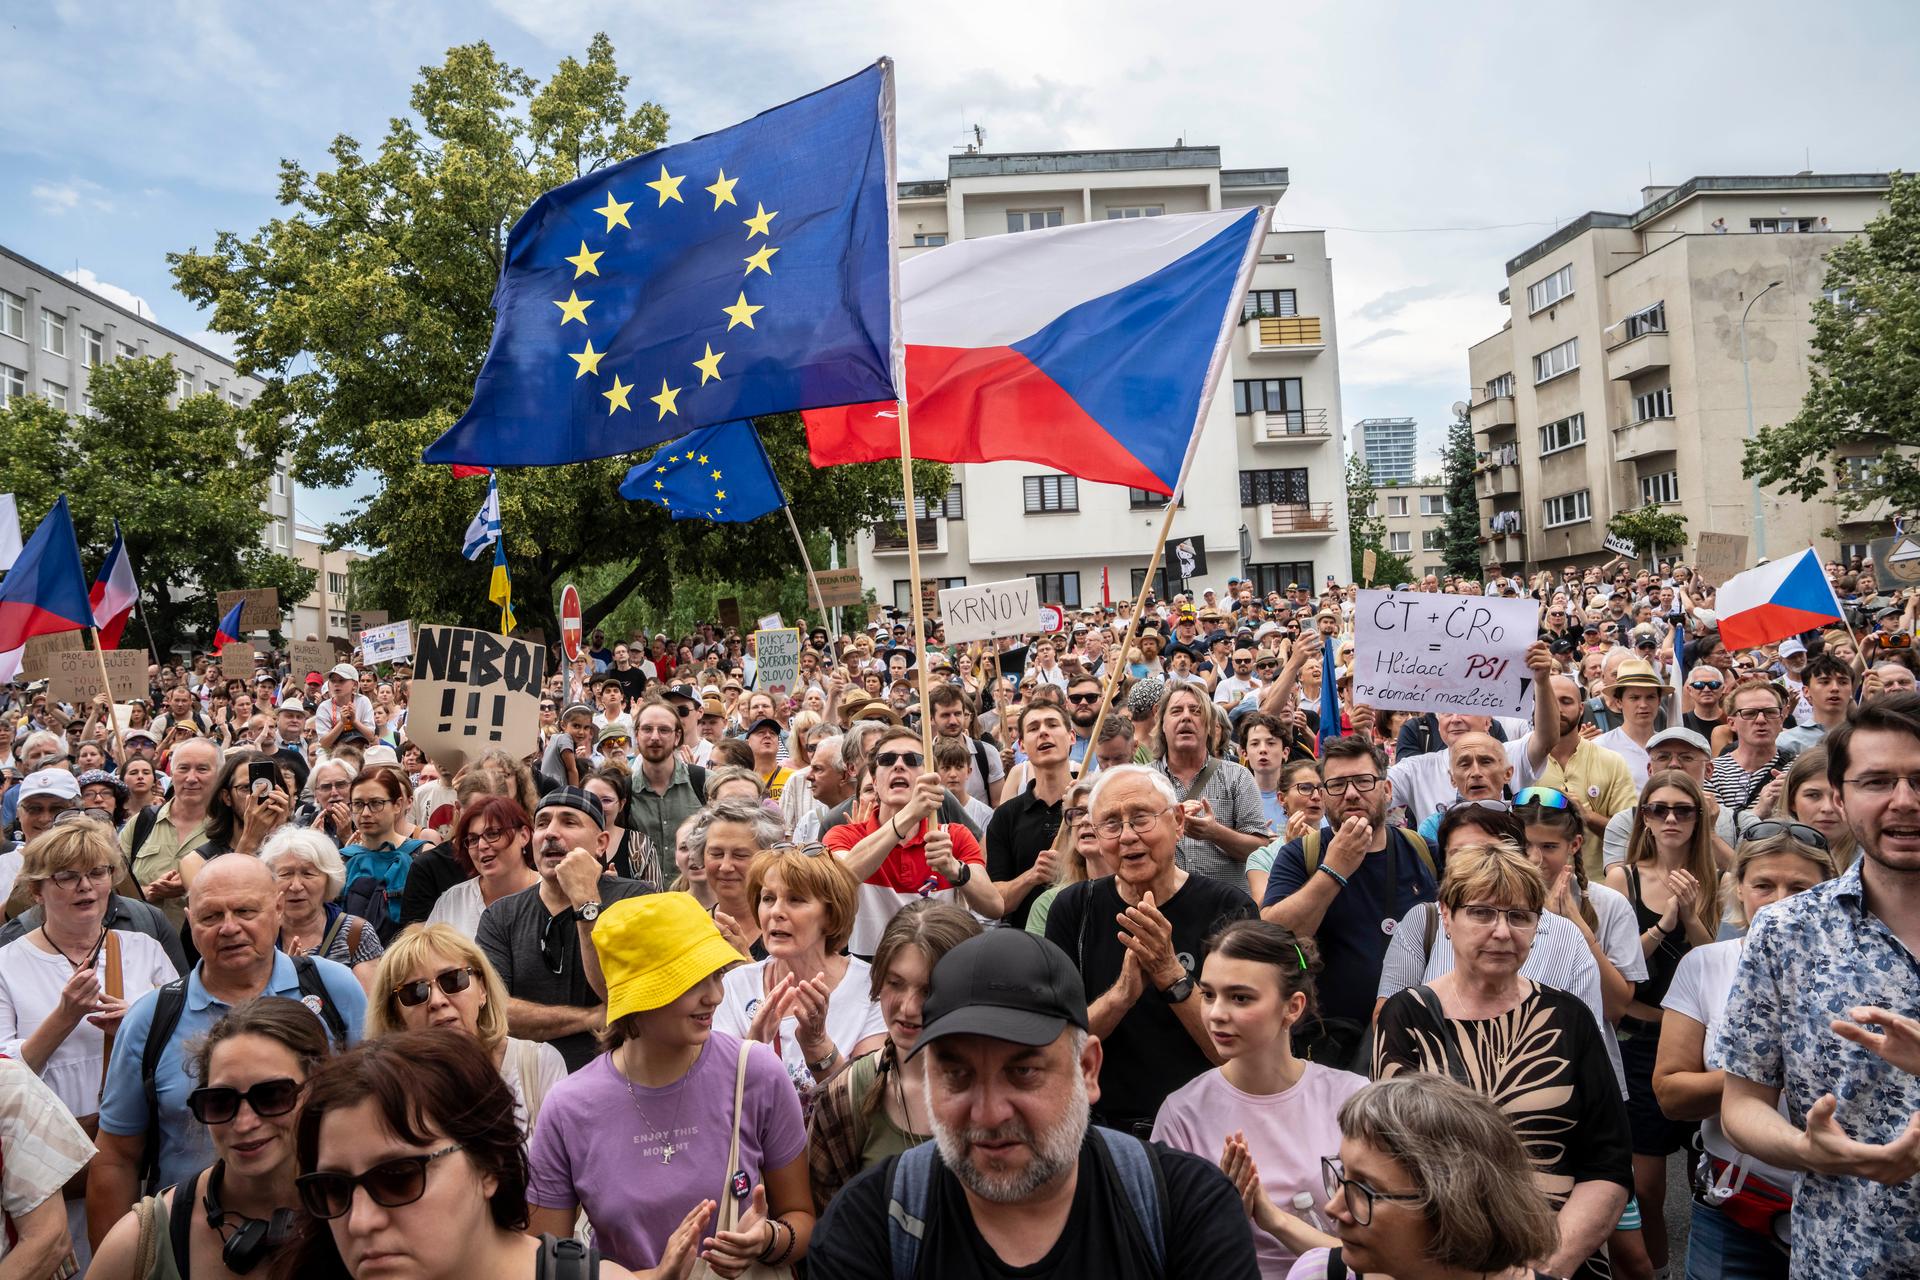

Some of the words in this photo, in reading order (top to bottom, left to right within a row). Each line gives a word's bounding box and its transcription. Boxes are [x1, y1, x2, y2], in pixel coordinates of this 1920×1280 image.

[948, 589, 1029, 625] KRNOV
[1374, 594, 1419, 632] ČT
[1427, 612, 1439, 623] +
[1445, 599, 1505, 643] ČRo
[786, 633, 798, 644] ZA
[1428, 643, 1441, 651] =
[61, 661, 78, 671] CO
[82, 657, 136, 670] FUGUJE?
[413, 627, 545, 699] NEBOJ
[1375, 650, 1448, 677] Hlídací
[760, 668, 794, 683] SLOVO
[1355, 684, 1374, 697] ne
[1378, 681, 1432, 702] domácí
[1434, 686, 1505, 708] mazlíčci
[1515, 677, 1532, 712] !
[437, 688, 506, 742] !!!
[633, 1130, 670, 1144] ENJOY
[672, 1126, 699, 1137] THIS
[643, 1142, 690, 1157] MOENT
